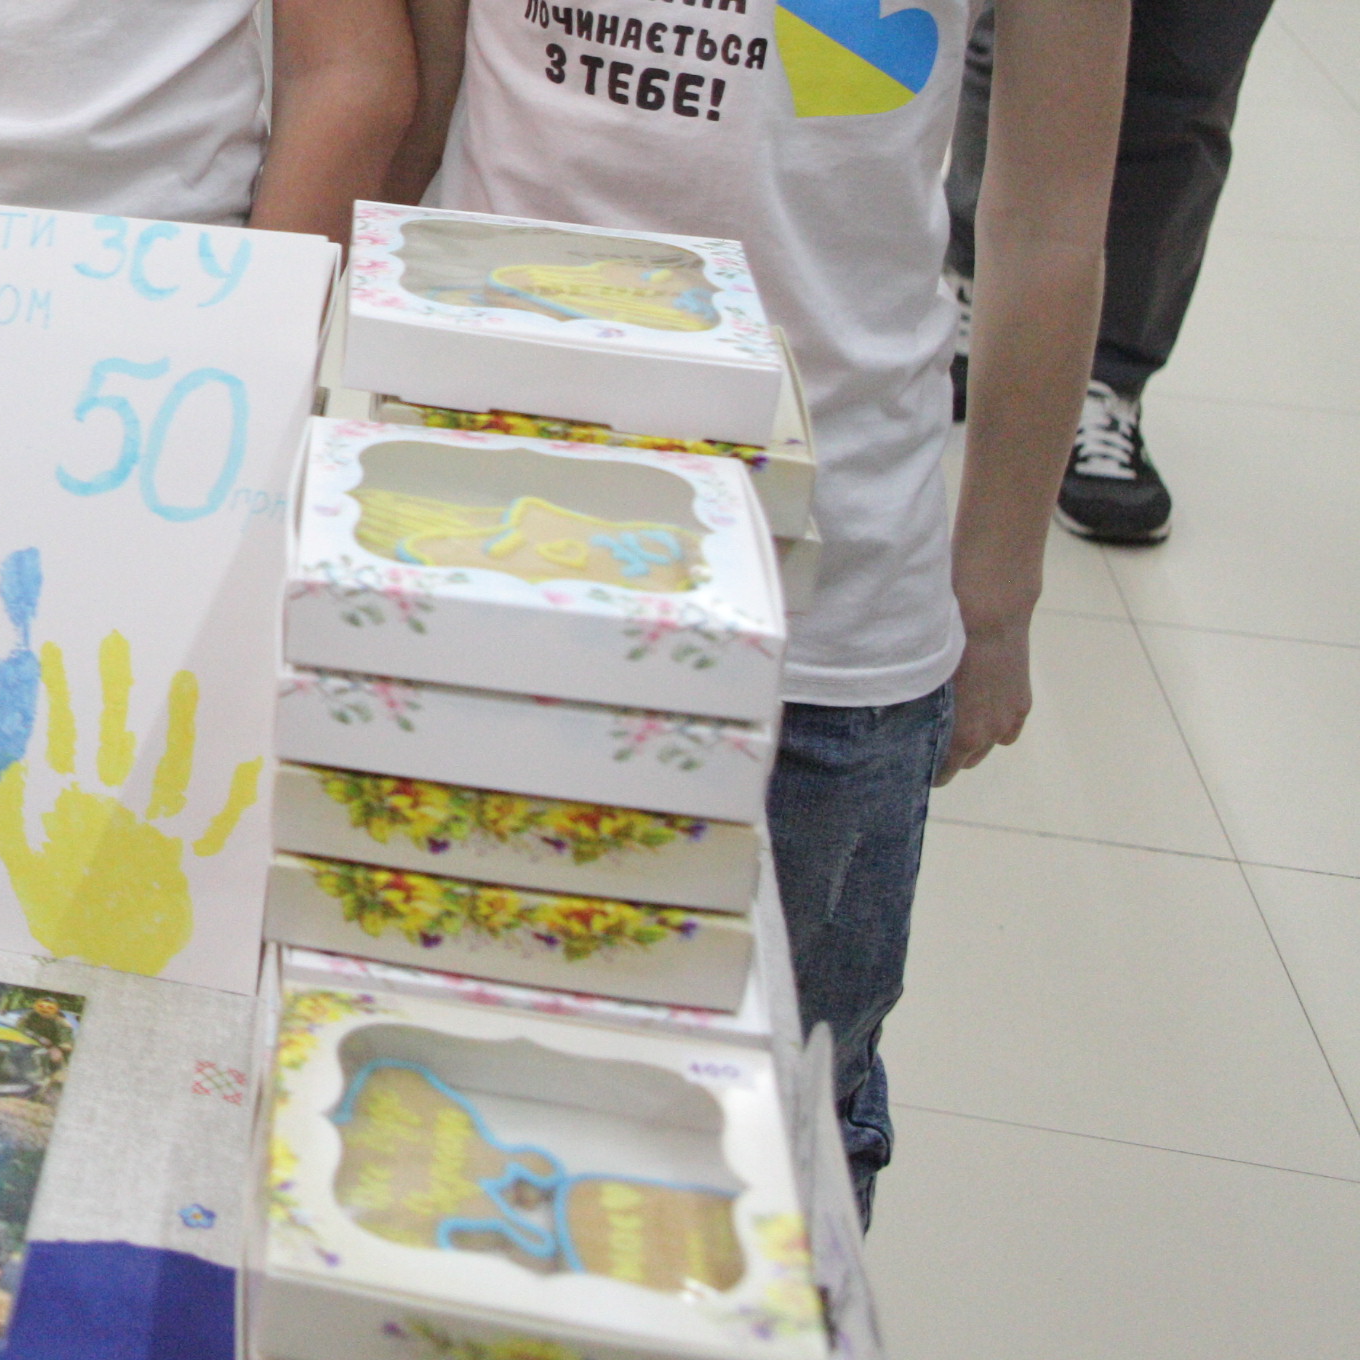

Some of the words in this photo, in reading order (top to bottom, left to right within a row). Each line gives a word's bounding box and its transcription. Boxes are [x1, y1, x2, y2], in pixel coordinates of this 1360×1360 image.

[544, 42, 567, 85] З
[579, 54, 727, 124] ТЕБЕ!
[73, 214, 252, 309] ЗСУ
[54, 356, 250, 524] 50
